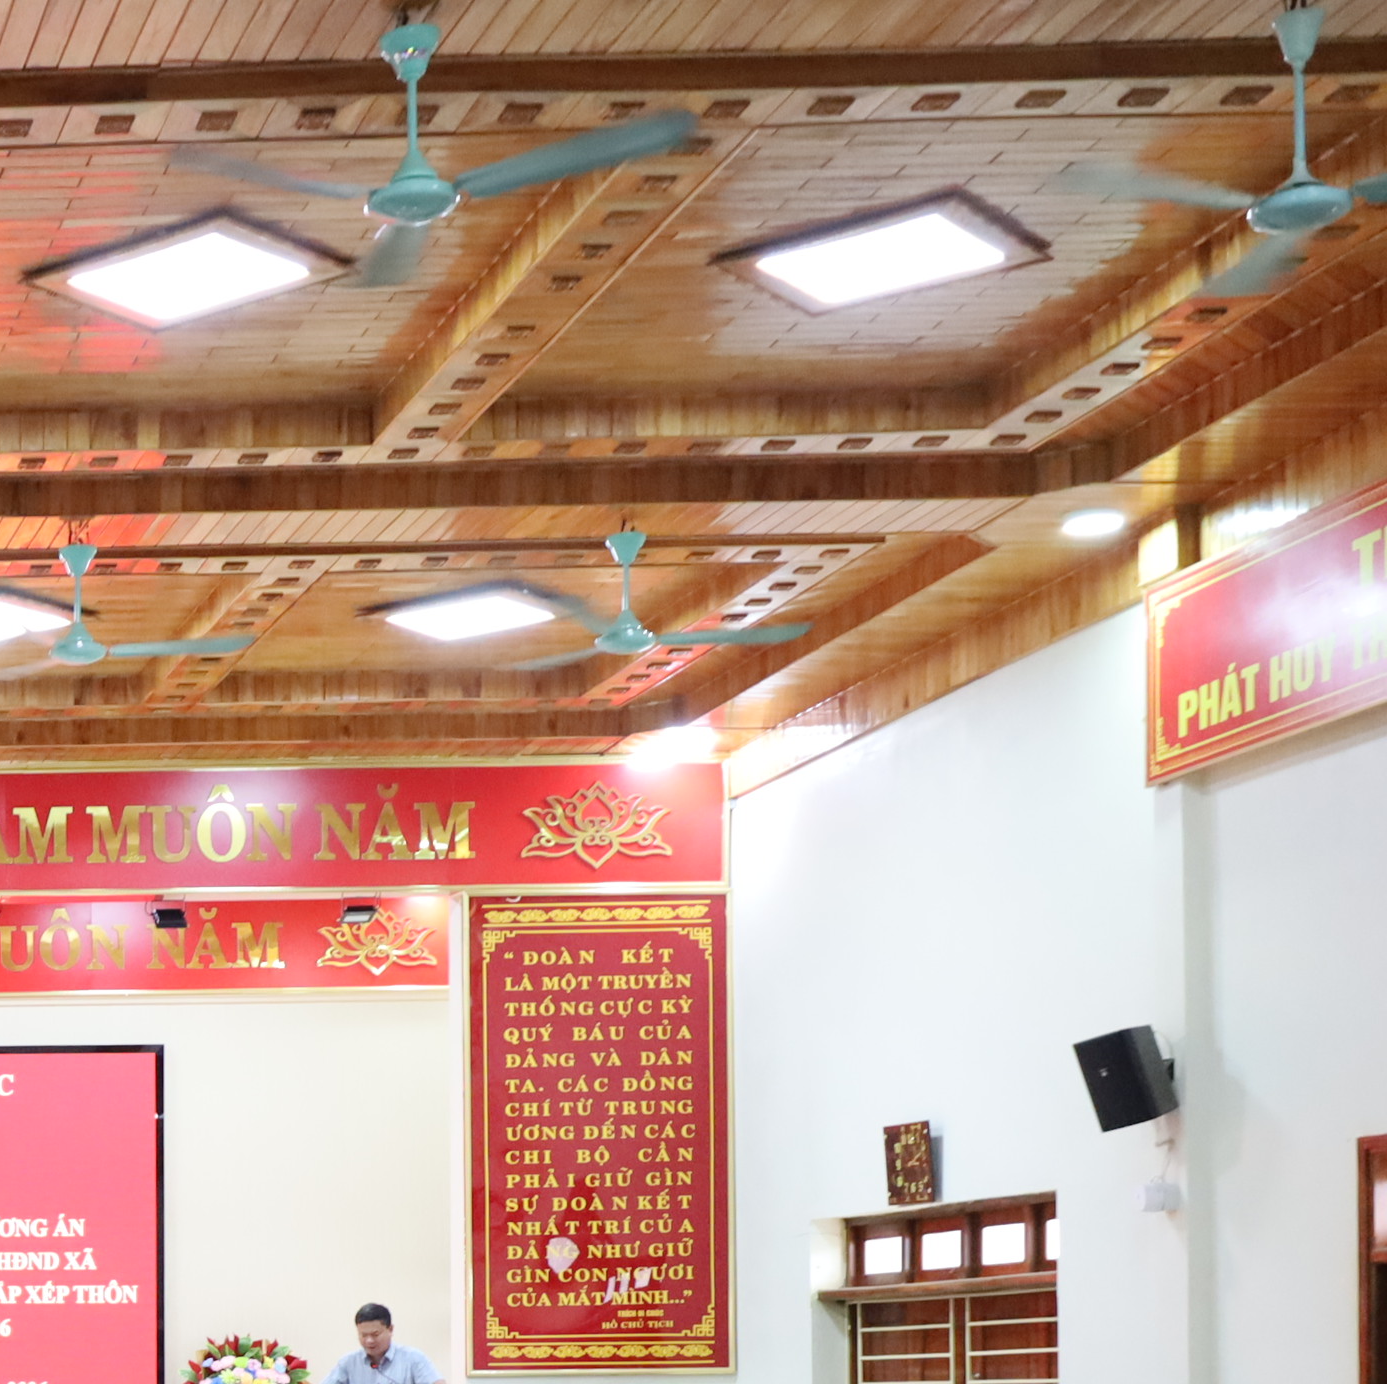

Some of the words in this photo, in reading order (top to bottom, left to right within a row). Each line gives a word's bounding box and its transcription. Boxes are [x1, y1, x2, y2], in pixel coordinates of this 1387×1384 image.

[1178, 662, 1260, 738] PHÁT
[1269, 634, 1337, 703] HUY
[86, 784, 303, 864] MUÔN
[314, 783, 475, 861] NĂM
[147, 907, 285, 970] NĂM
[523, 947, 595, 965] ĐOÀN
[622, 942, 673, 963] KẾT
[505, 974, 533, 991] LÀ
[542, 973, 592, 993] MỘT
[598, 967, 692, 988] TRUYỀN
[505, 996, 594, 1016] THỐNG
[600, 998, 652, 1018] CỰC
[661, 996, 693, 1013] KỲ
[503, 1024, 553, 1044] QUÝ
[573, 1023, 624, 1041] BÁU
[639, 1020, 692, 1039] CỦA
[505, 1048, 575, 1068] ĐẢNG
[590, 1049, 621, 1066] VÀ
[640, 1048, 692, 1065] DÂN
[505, 1079, 544, 1093] TA.
[558, 1076, 608, 1092] CÁC
[623, 1070, 693, 1091] ĐỒNG
[505, 1099, 551, 1116] CHÍ
[560, 1099, 593, 1116] TỪ
[605, 1100, 693, 1114] TRUNG
[53, 1214, 85, 1237] ÁN
[64, 1248, 97, 1270] XÃ
[587, 1242, 640, 1258] NHƯ
[649, 1239, 693, 1256] GIỮ
[507, 1266, 550, 1283] GÌN
[558, 1269, 608, 1283] CON
[73, 1280, 138, 1304] THÔN
[507, 1286, 551, 1307] CỦA
[558, 1285, 605, 1306] MẮT
